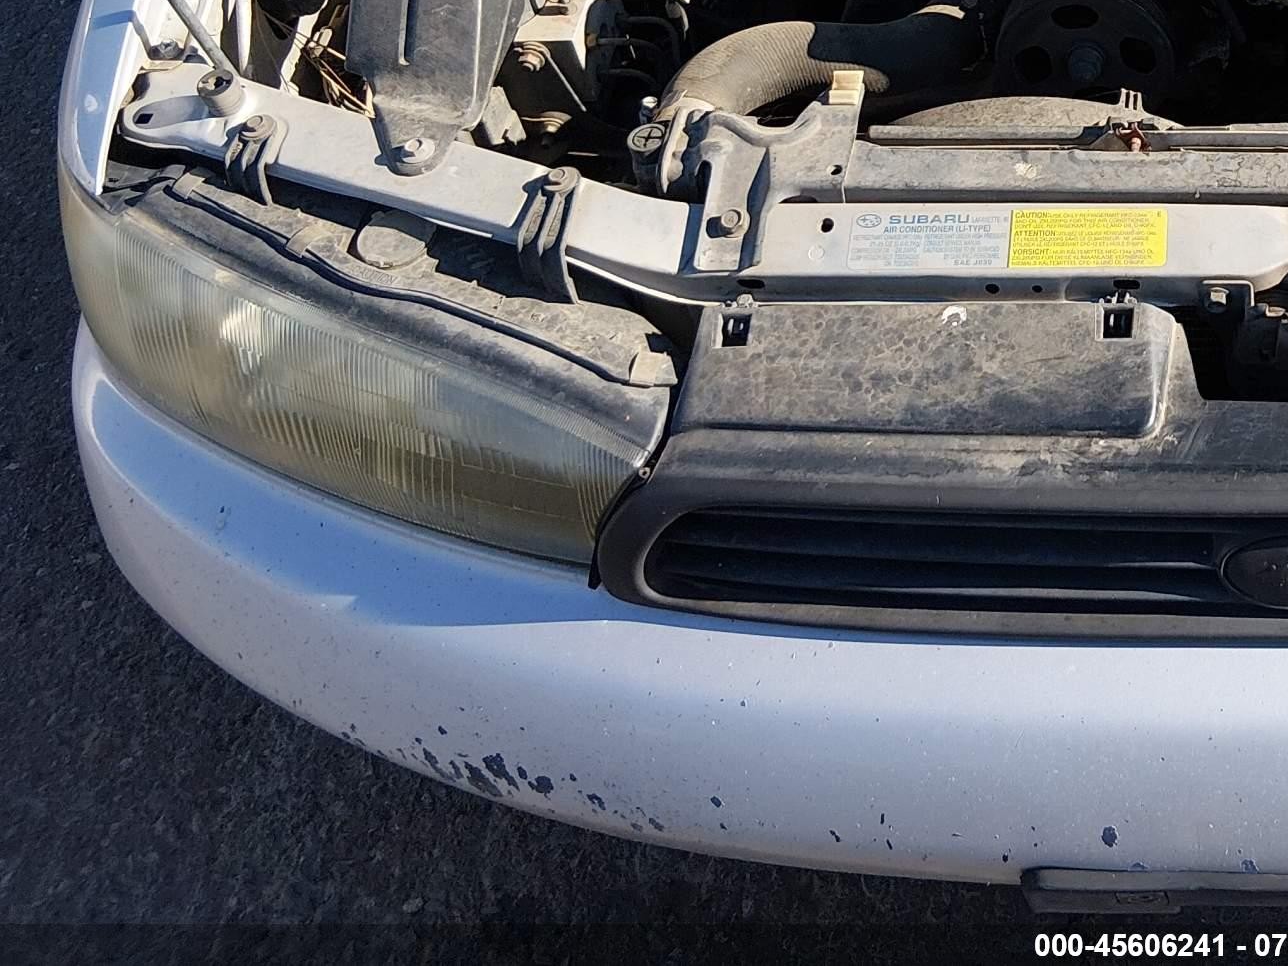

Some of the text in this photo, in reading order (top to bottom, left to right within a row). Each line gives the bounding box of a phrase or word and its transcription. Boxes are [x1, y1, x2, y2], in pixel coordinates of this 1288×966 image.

[888, 214, 970, 224] SUBARU
[883, 225, 897, 234] AIR
[899, 225, 954, 234] CONDITIONER
